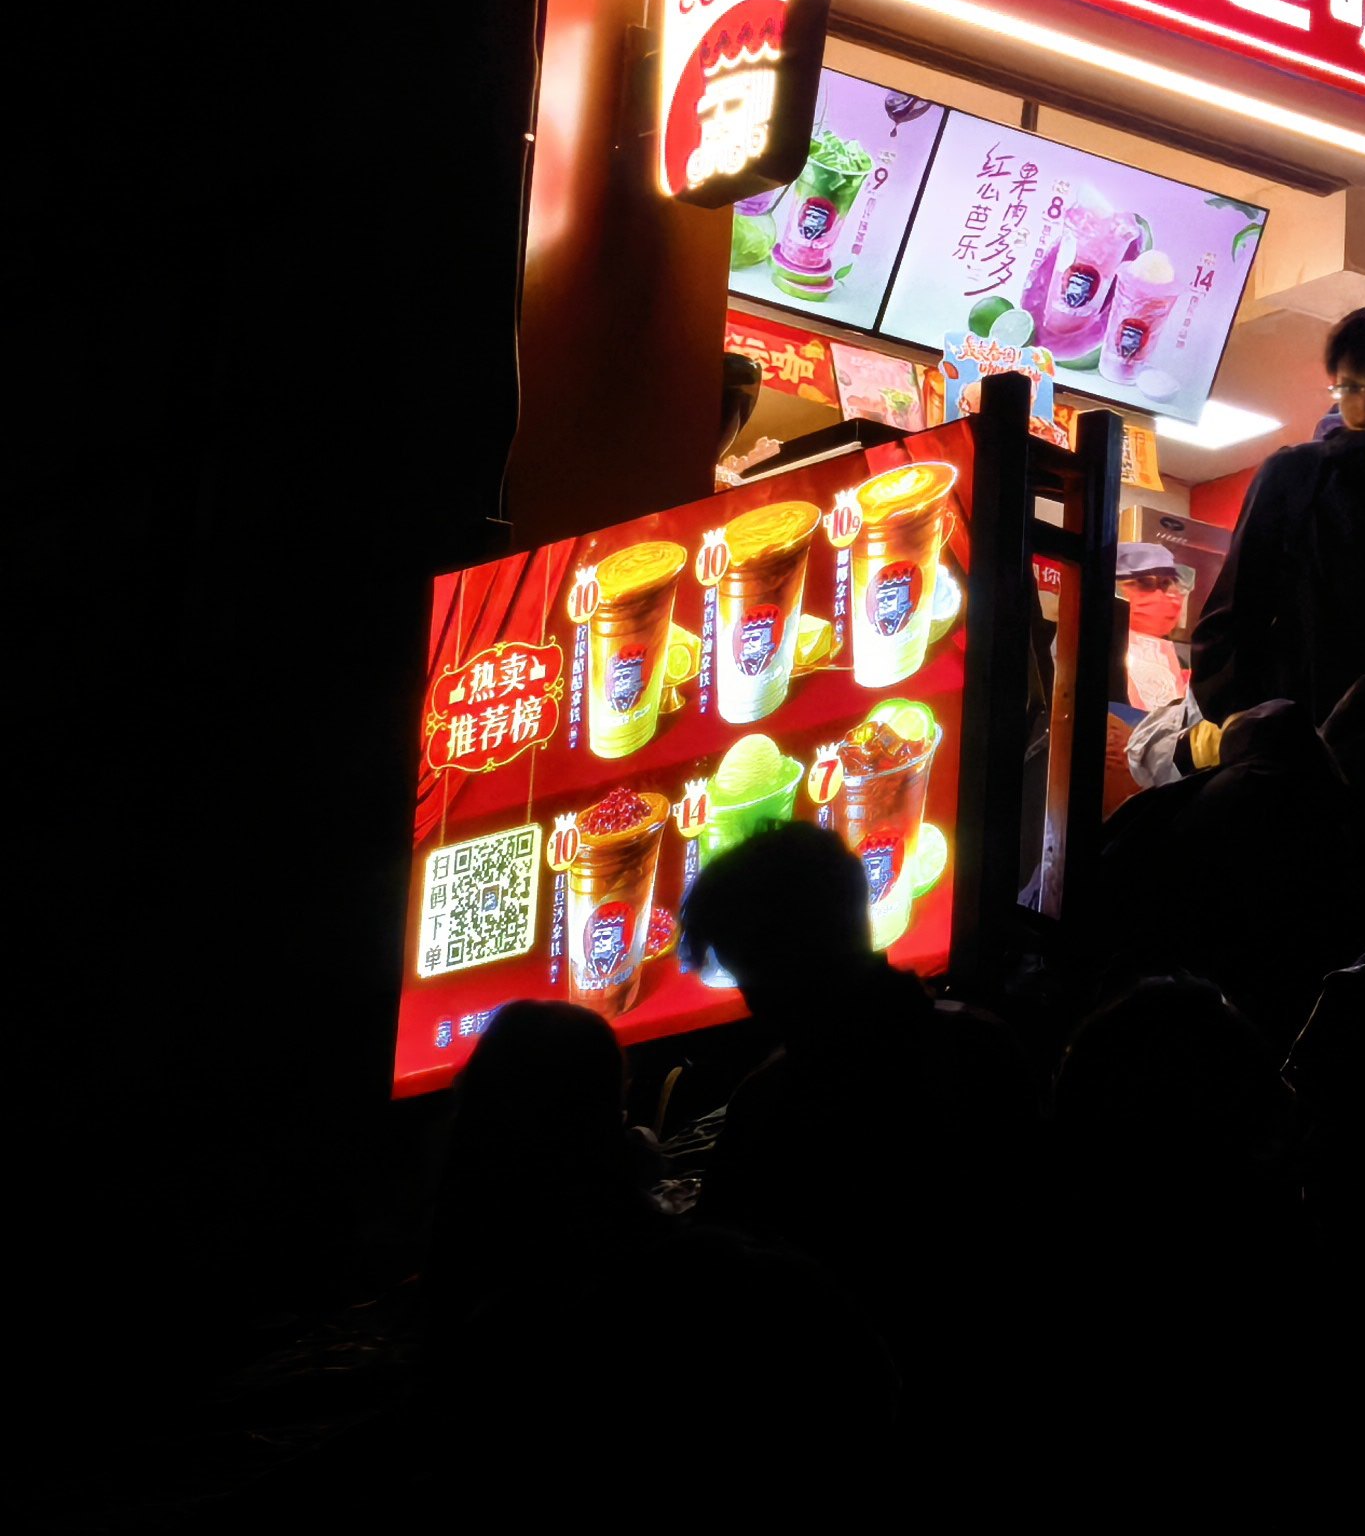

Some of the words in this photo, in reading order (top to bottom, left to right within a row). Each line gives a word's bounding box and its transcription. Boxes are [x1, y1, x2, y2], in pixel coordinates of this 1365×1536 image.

[873, 166, 889, 191] 9
[951, 141, 1016, 261] 红心芭乐
[1047, 196, 1064, 220] 8
[1193, 265, 1215, 292] 14
[467, 653, 530, 707] 热卖
[446, 695, 544, 761] 推荐榜
[423, 853, 449, 972] 扫码下单
